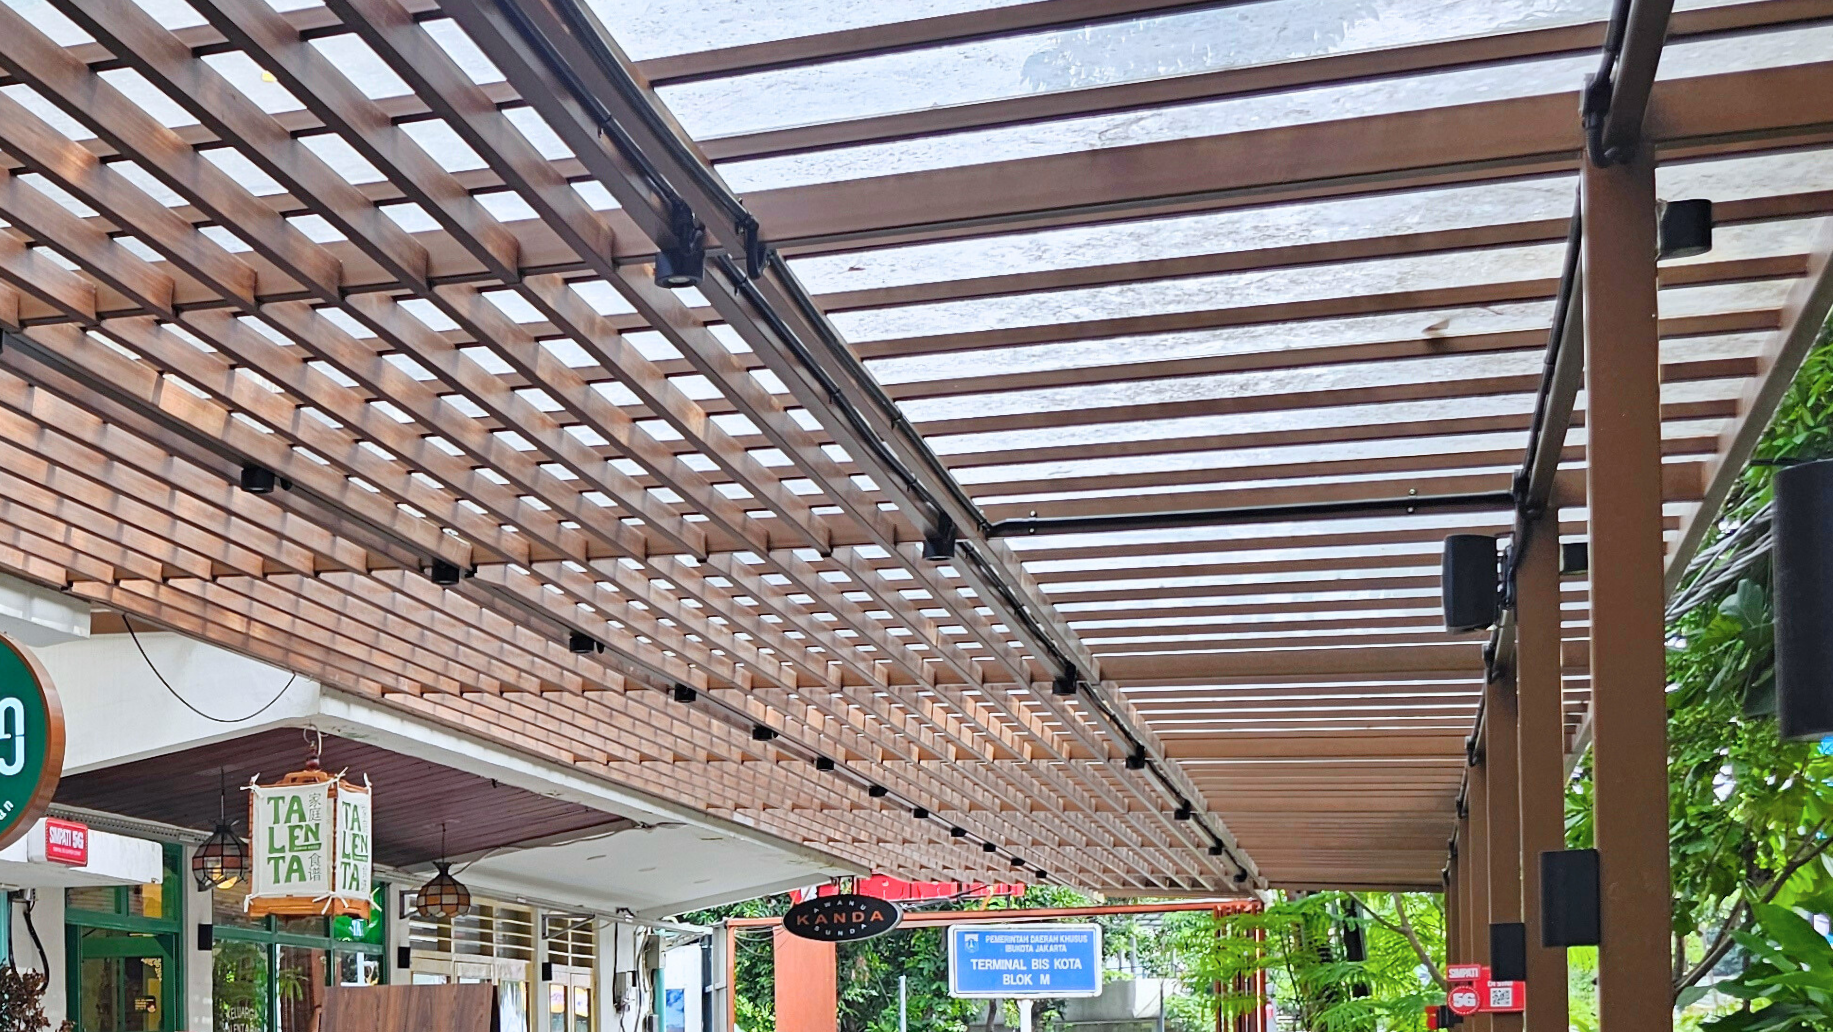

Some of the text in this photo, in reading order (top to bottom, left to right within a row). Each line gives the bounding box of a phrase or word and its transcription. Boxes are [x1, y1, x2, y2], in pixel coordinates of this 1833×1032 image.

[49, 826, 84, 850] SIMPATI 5G
[796, 910, 884, 926] KANDA
[814, 923, 867, 936] SUNDA
[985, 934, 1088, 944] PEMERINTAH DAERAH KHUSUS
[1035, 944, 1067, 953] JAKARTA
[970, 958, 1082, 970] TERMINAL BIS KOTA
[1448, 967, 1479, 979] SIMPATI
[1002, 974, 1050, 985] BLOK M
[1452, 992, 1477, 1008] 5G
